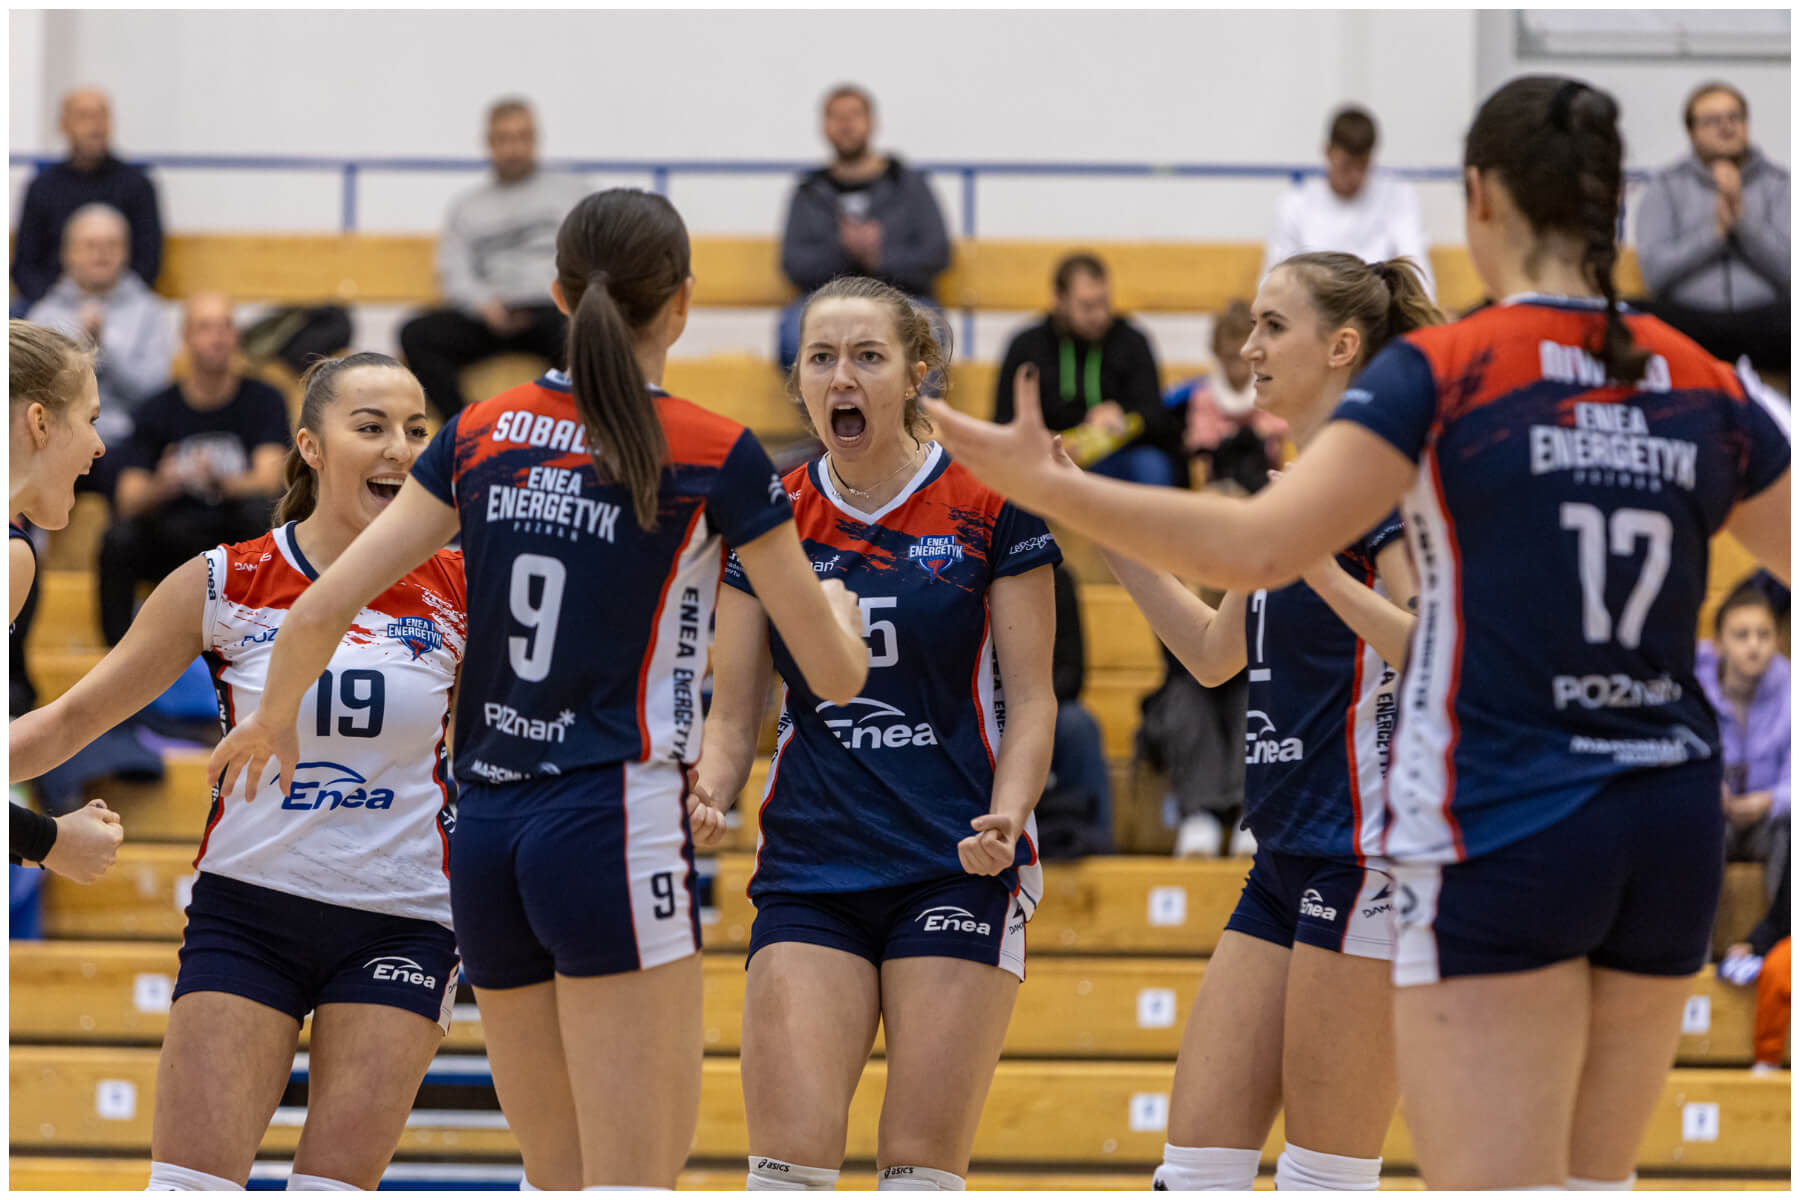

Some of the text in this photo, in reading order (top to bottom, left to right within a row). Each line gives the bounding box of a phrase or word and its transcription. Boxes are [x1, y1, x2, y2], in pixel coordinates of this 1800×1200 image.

[492, 410, 588, 454] SOBAL
[527, 466, 582, 496] ENEA
[486, 485, 621, 544] ENERGETYK
[909, 544, 963, 559] ENERGETYK
[927, 537, 949, 546] ENEA
[1560, 503, 1672, 649] 17
[406, 618, 429, 630] ENEA
[509, 553, 567, 682] 9
[676, 587, 699, 659] ENEA
[315, 669, 386, 738] 19
[281, 781, 395, 810] Enea
[651, 872, 675, 919] 9
[923, 915, 991, 936] Enea
[372, 963, 436, 990] Enea
[767, 1163, 790, 1172] asics
[891, 1166, 914, 1175] asics
